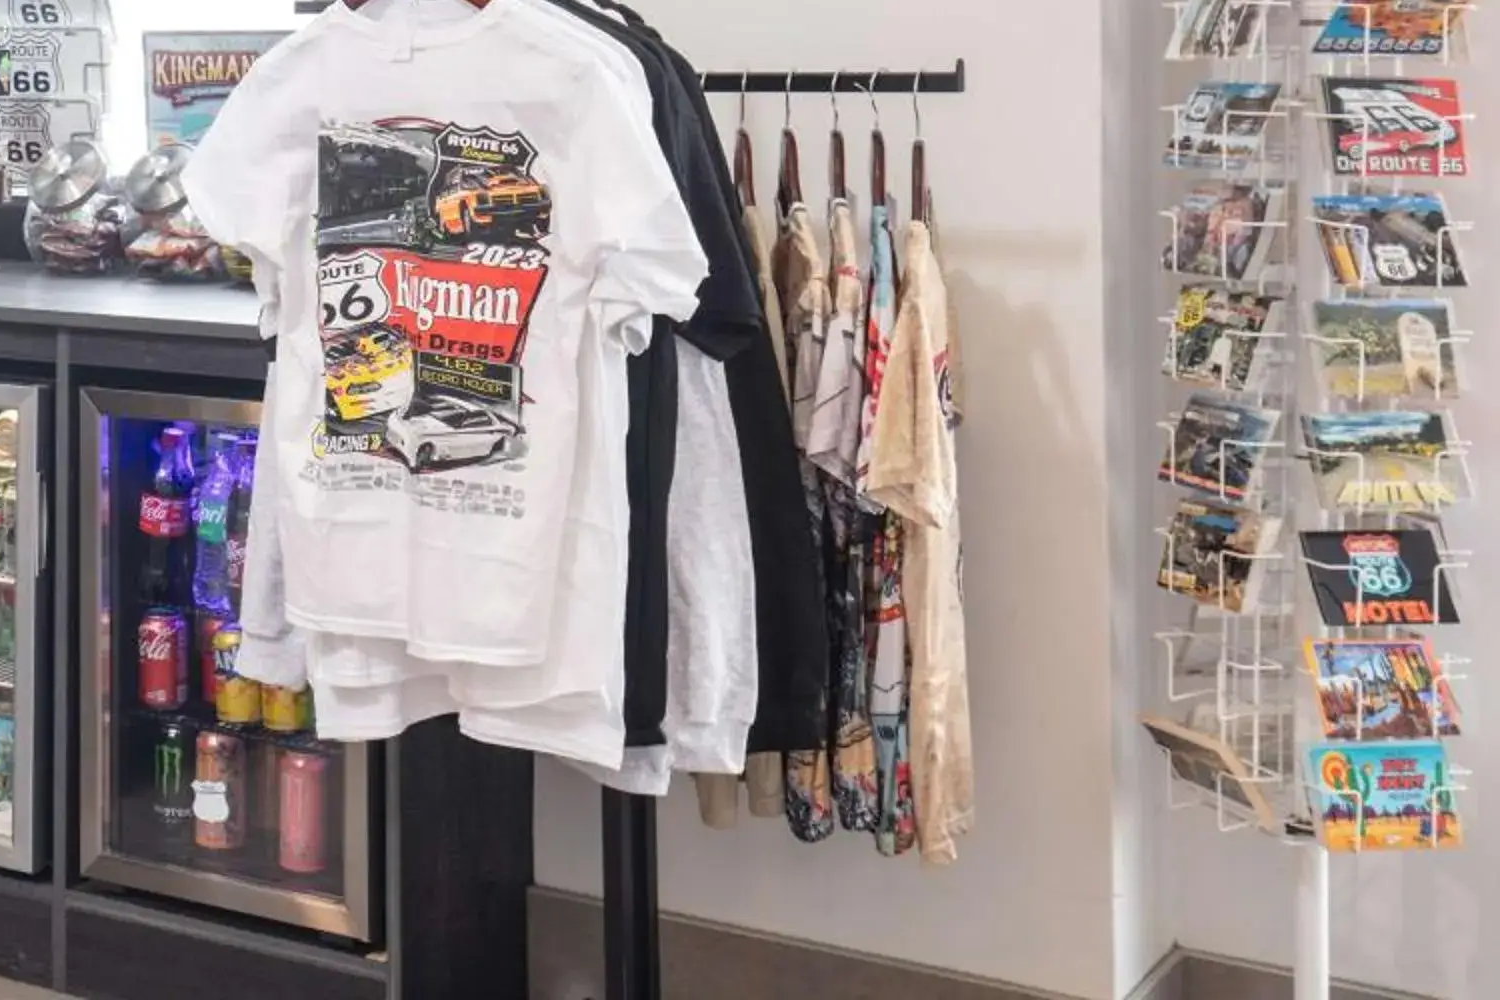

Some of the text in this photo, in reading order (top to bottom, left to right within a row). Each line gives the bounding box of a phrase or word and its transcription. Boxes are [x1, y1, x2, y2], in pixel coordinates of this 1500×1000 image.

[21, 3, 60, 24] 66
[11, 45, 49, 57] ROUTE
[13, 70, 50, 93] 66
[0, 115, 40, 128] ROUTE
[7, 141, 43, 164] 66
[447, 134, 519, 156] ROUTE 66
[1369, 156, 1432, 172] ROUTE
[461, 243, 546, 270] 2023
[320, 264, 365, 282] OUTE
[428, 333, 505, 359] Drags
[1362, 566, 1402, 590] 66
[1342, 600, 1440, 623] MOTEL
